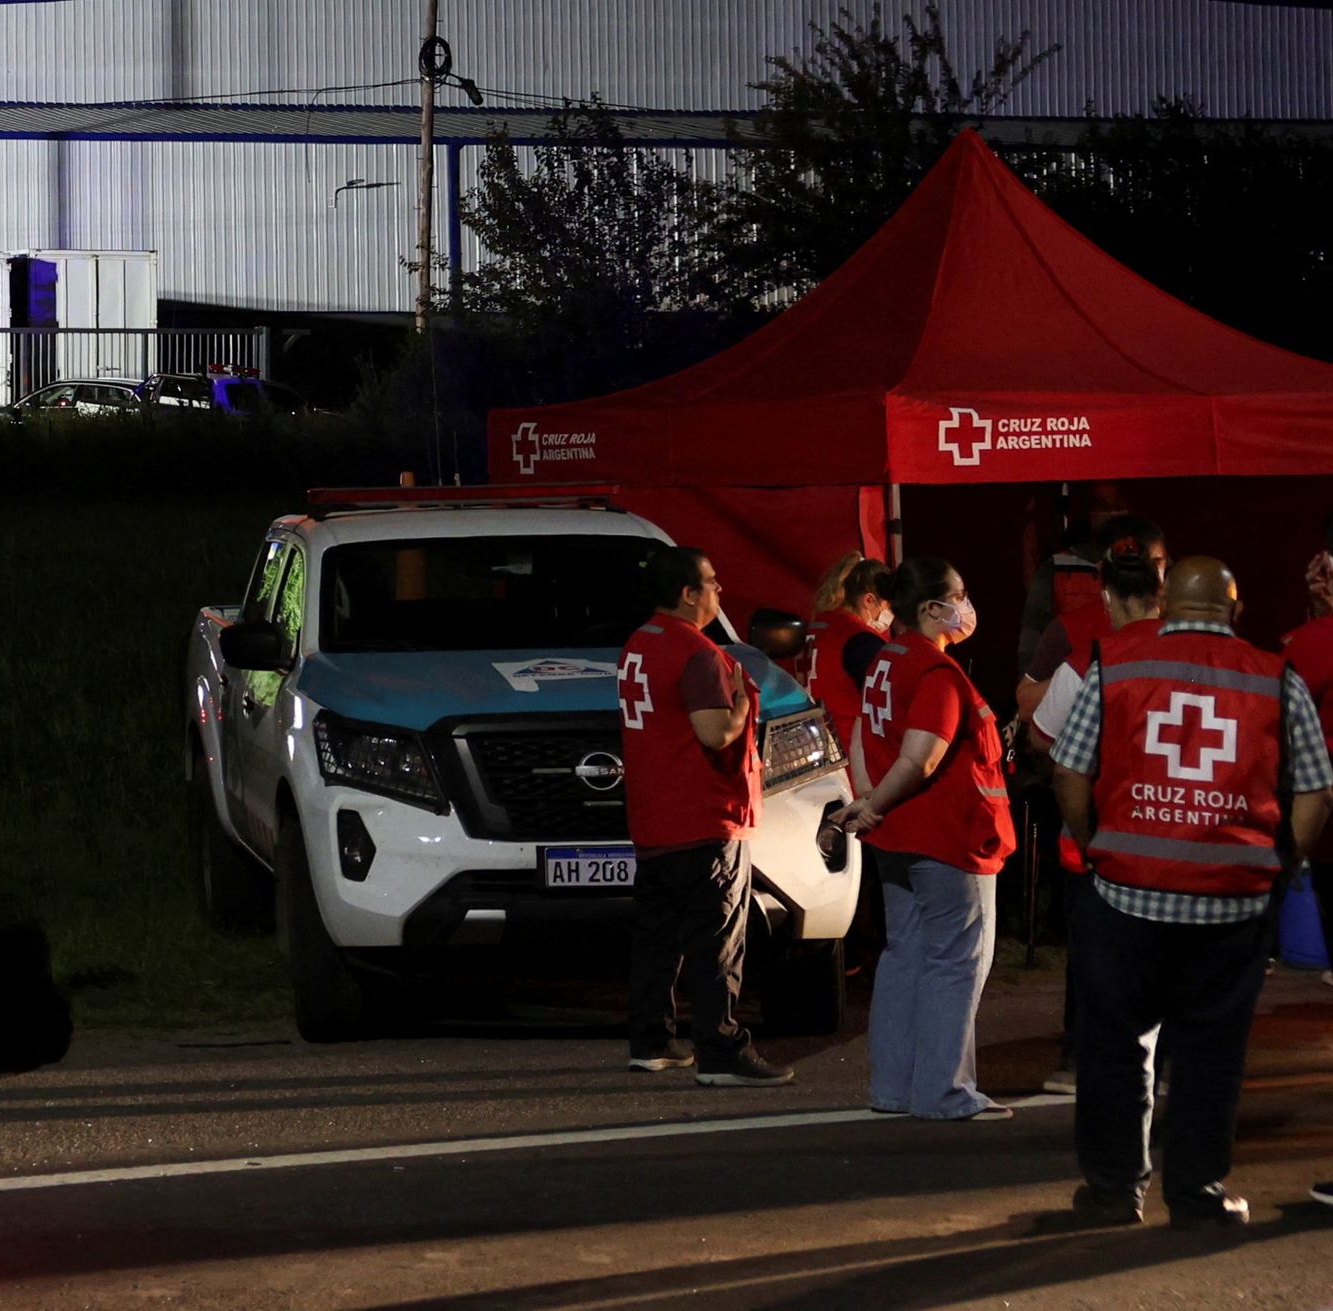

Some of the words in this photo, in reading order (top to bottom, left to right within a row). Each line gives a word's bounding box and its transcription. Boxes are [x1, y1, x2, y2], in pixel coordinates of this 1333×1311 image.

[998, 419, 1042, 432] CRUZ
[1047, 417, 1090, 431] ROJA
[542, 434, 569, 445] CRUZ
[569, 432, 596, 444] ROJA
[996, 434, 1092, 450] ARGENTINA
[542, 448, 596, 461] ARGENTINA
[1132, 784, 1185, 804] CRUZ
[1194, 790, 1248, 811] ROJA
[1132, 807, 1244, 826] ARGENTI
[553, 861, 580, 883] AH
[588, 861, 628, 882] 208
